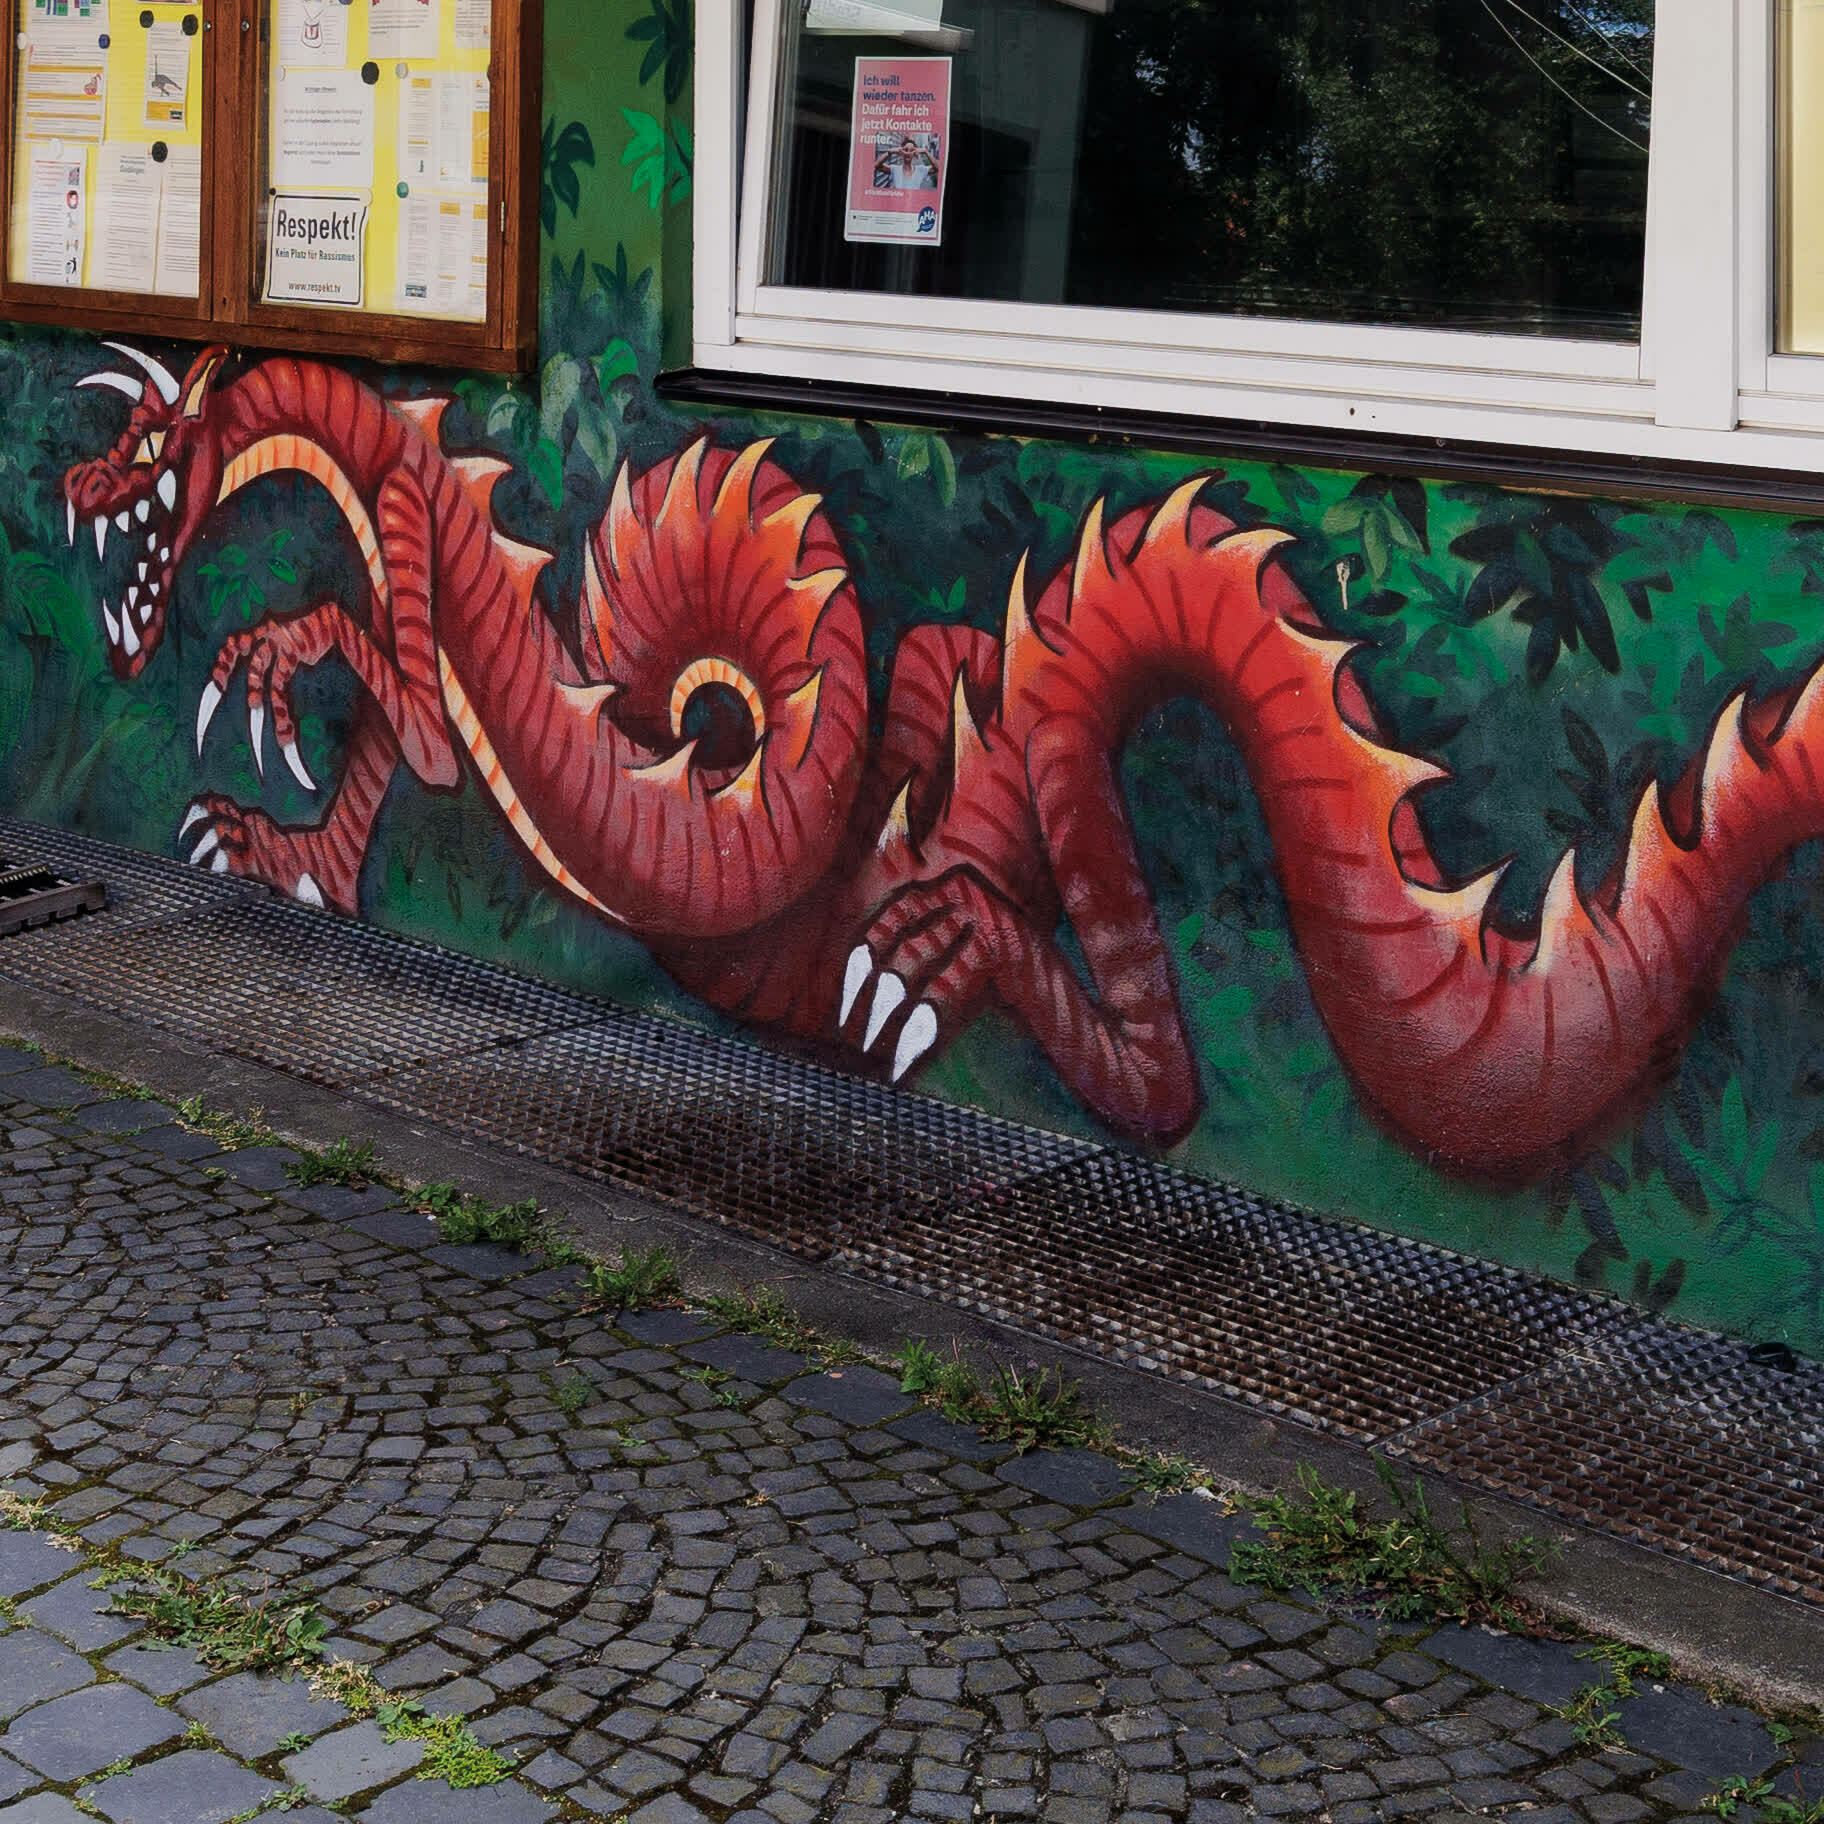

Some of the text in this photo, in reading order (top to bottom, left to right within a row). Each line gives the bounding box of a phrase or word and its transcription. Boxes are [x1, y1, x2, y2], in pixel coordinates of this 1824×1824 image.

[880, 74, 900, 87] will
[863, 90, 898, 102] wieder
[861, 103, 890, 116] Dafür
[891, 103, 912, 116] fahr
[860, 118, 932, 133] jetzt Kontakte
[859, 133, 893, 145] runter.
[276, 209, 357, 244] Respekt!
[275, 247, 355, 262] Kein Platz für Rassismus
[288, 281, 341, 294] www.respekt.tv
